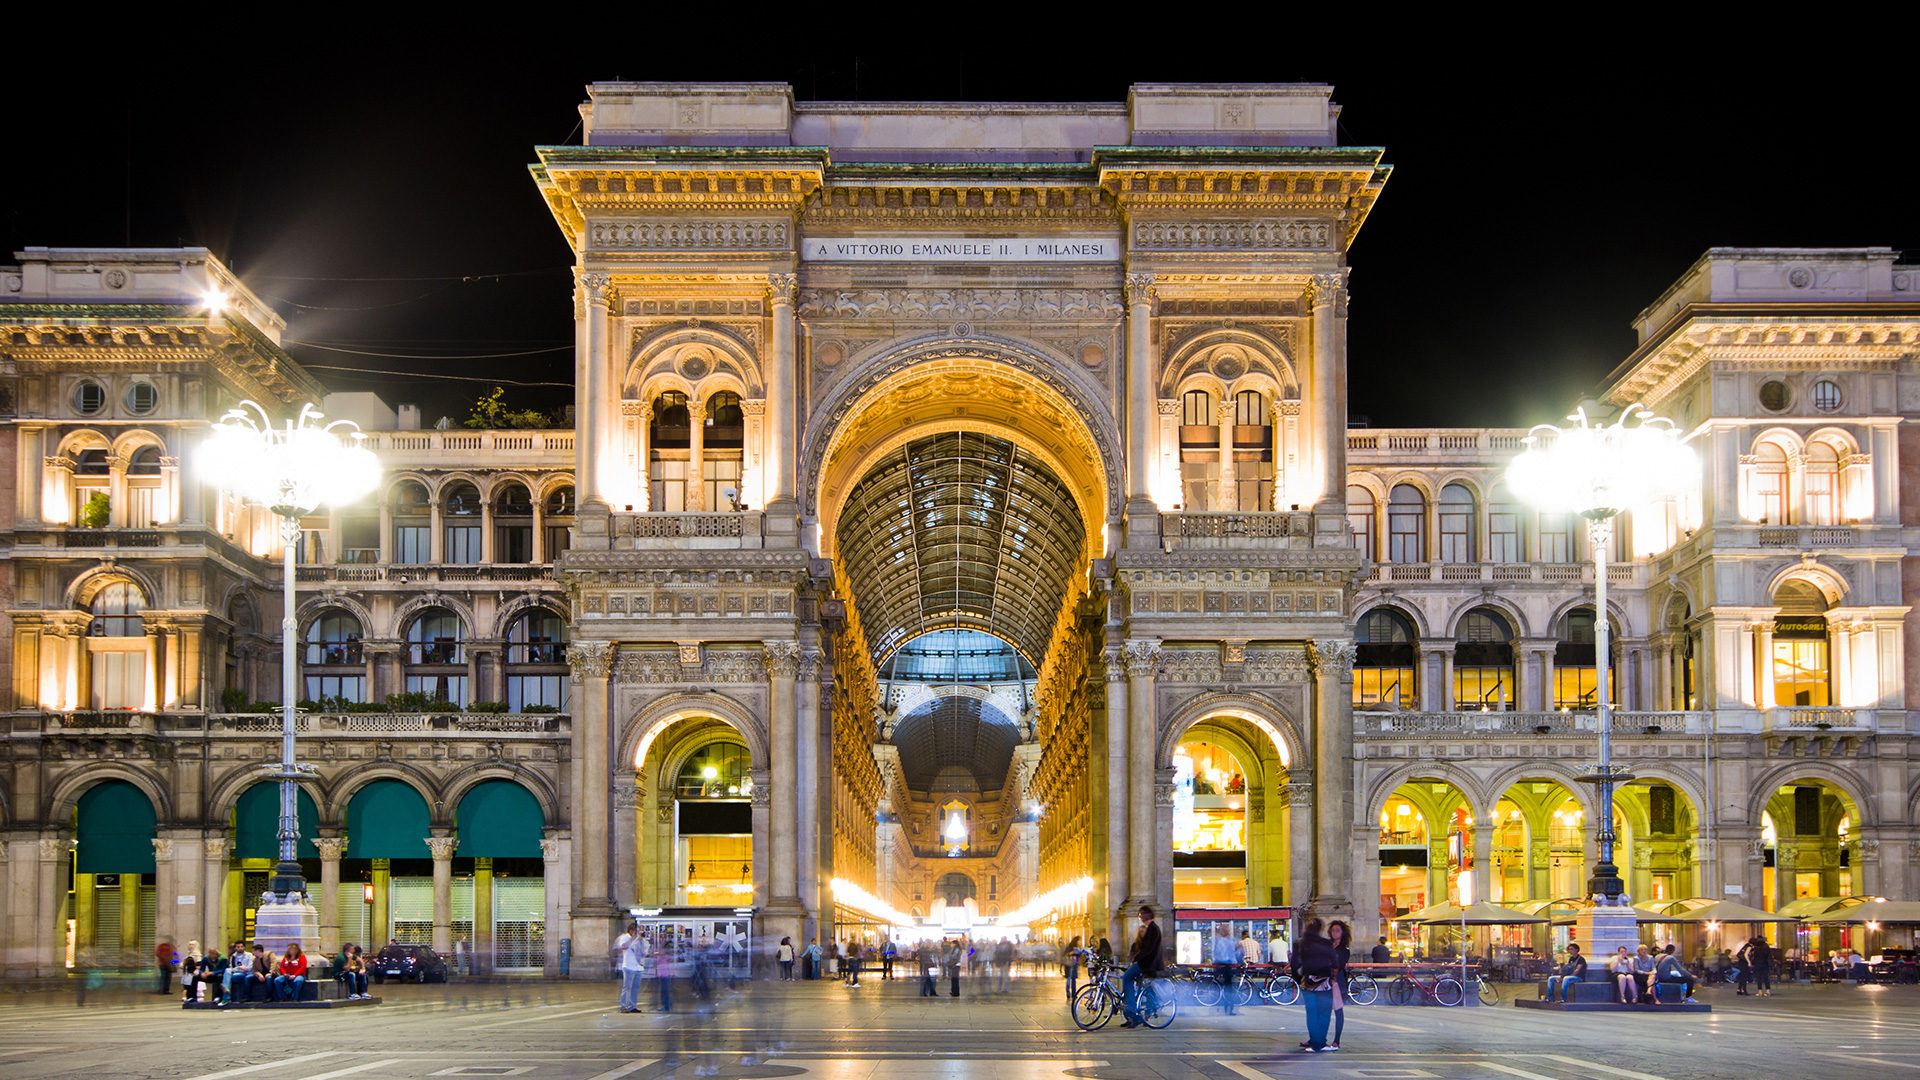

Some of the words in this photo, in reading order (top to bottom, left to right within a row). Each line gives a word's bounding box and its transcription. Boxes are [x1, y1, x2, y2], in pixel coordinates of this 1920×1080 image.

[818, 245, 828, 255] A
[837, 245, 904, 255] VITTORIO
[912, 245, 992, 255] EMANUELE
[999, 245, 1012, 255] II.
[1037, 245, 1103, 255] MILANESI
